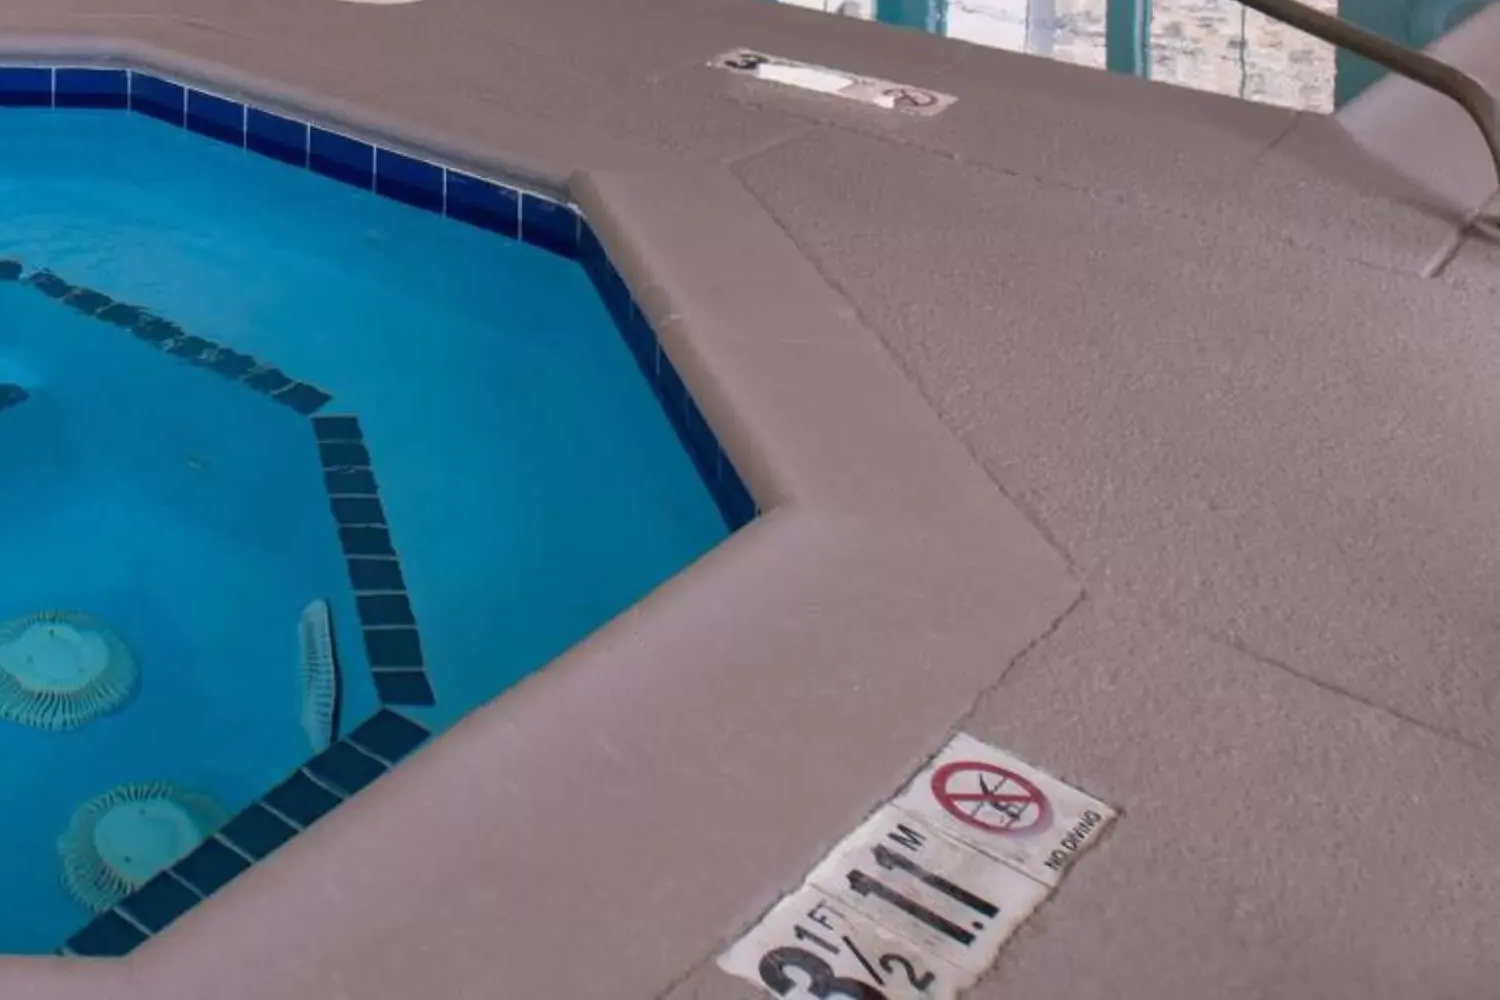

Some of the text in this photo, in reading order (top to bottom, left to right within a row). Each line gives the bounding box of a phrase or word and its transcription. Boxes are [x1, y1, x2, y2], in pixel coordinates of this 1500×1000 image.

[887, 823, 927, 851] M
[1044, 809, 1102, 872] NO DIVING
